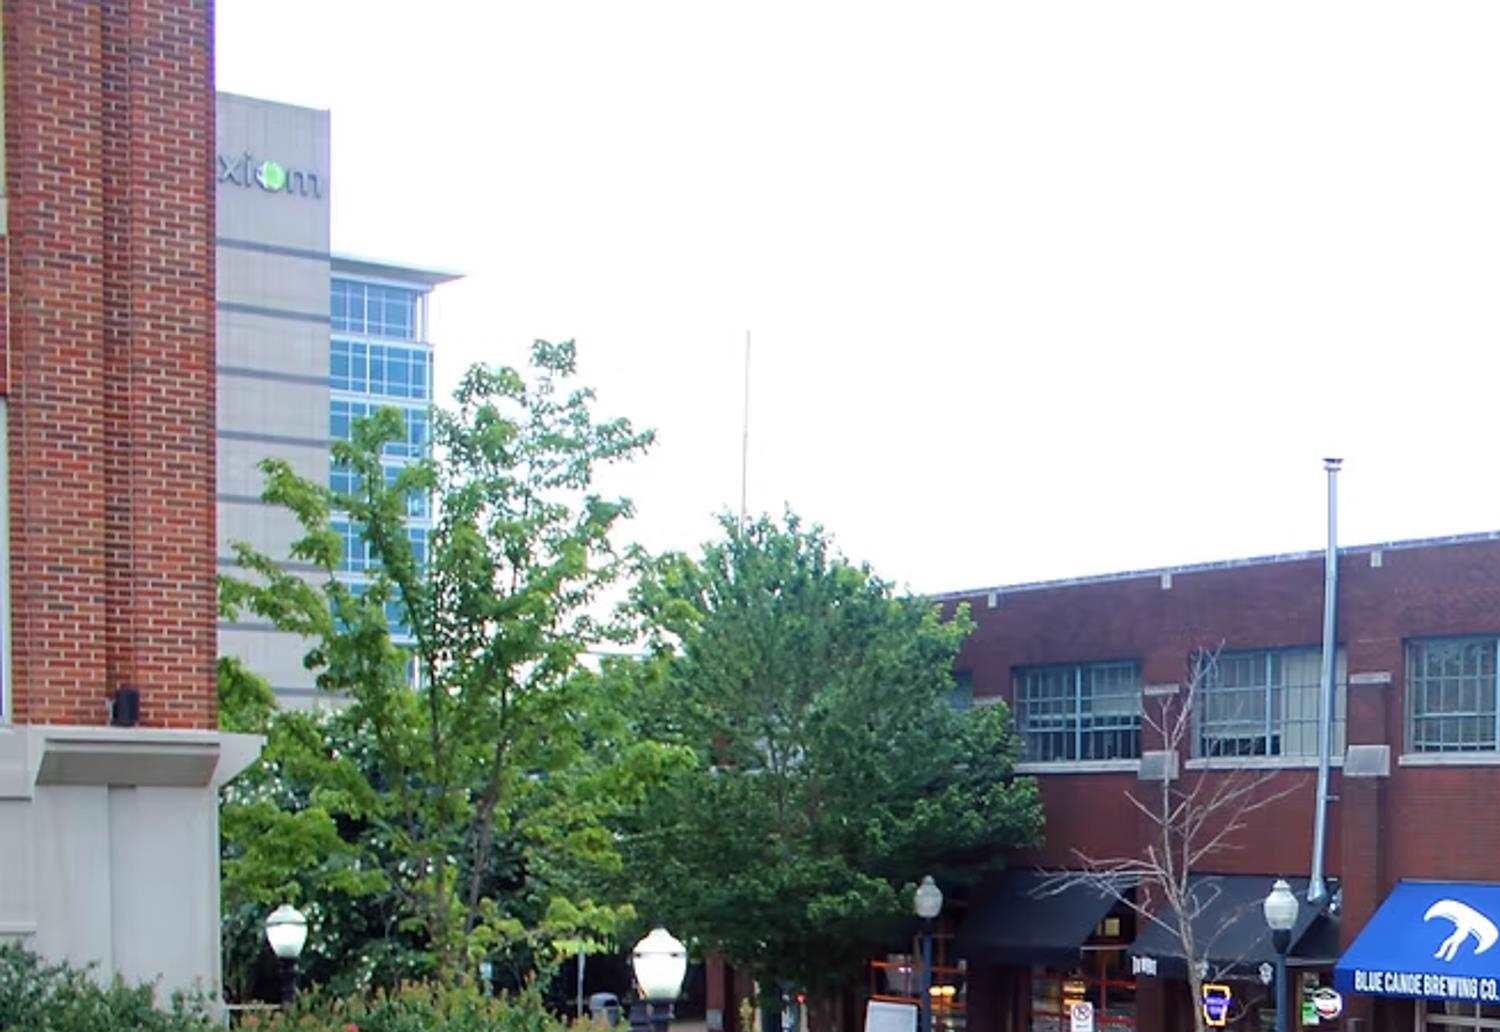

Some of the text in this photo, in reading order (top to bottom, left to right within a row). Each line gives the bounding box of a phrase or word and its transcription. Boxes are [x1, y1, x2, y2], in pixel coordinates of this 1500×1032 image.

[1355, 969, 1500, 1001] BLUE CANOE BREWING CO.
